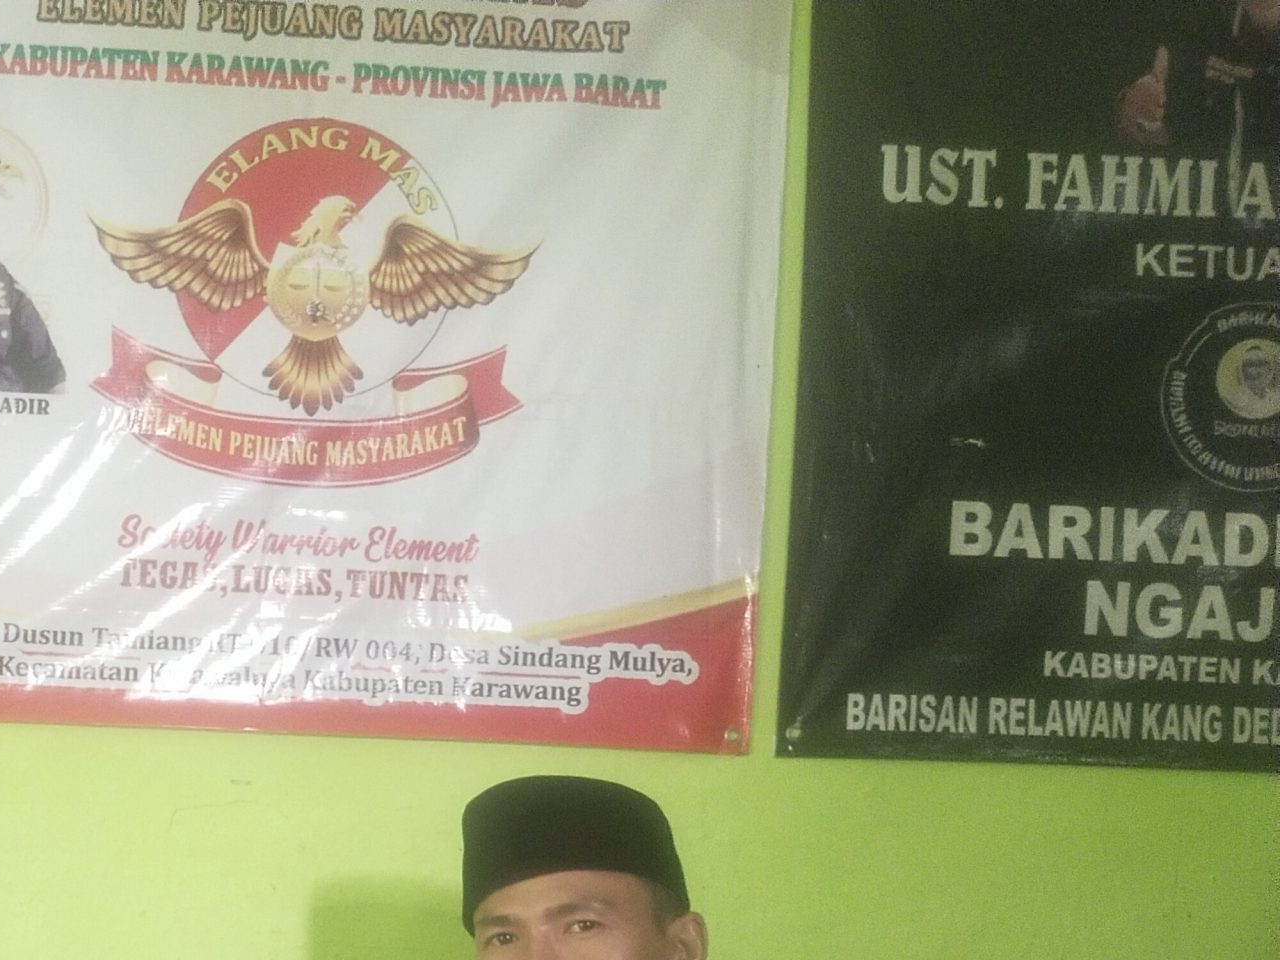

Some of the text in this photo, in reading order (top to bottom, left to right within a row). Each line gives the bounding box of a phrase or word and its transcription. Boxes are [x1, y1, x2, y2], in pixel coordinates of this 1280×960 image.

[36, 0, 630, 53] ELEMEN PEJUANG MASYARAKAT
[164, 49, 330, 93] KARAWANG
[352, 61, 486, 101] PROVINSI
[489, 68, 567, 109] JAWA
[574, 72, 667, 110] BARAT
[206, 125, 439, 216] ELANG MAS
[881, 143, 1004, 210] UST.
[1025, 151, 1218, 219] FAHMI
[1135, 243, 1280, 281] KETUA
[229, 430, 319, 467] PEJUANG
[325, 416, 467, 467] MASYARAKAT
[231, 519, 360, 560] Warrior
[365, 526, 481, 564] Element
[948, 500, 1280, 569] BARIKAD
[2, 622, 84, 647] Dusun
[497, 644, 602, 675] Sindang
[608, 650, 693, 678] Mulya,
[1043, 650, 1241, 685] KABUPATEN
[303, 669, 444, 698] Kabupaten
[452, 676, 582, 707] Karawang
[846, 692, 979, 735] BARISAN
[988, 697, 1133, 740] RELAWAN
[1141, 702, 1222, 743] KANG
